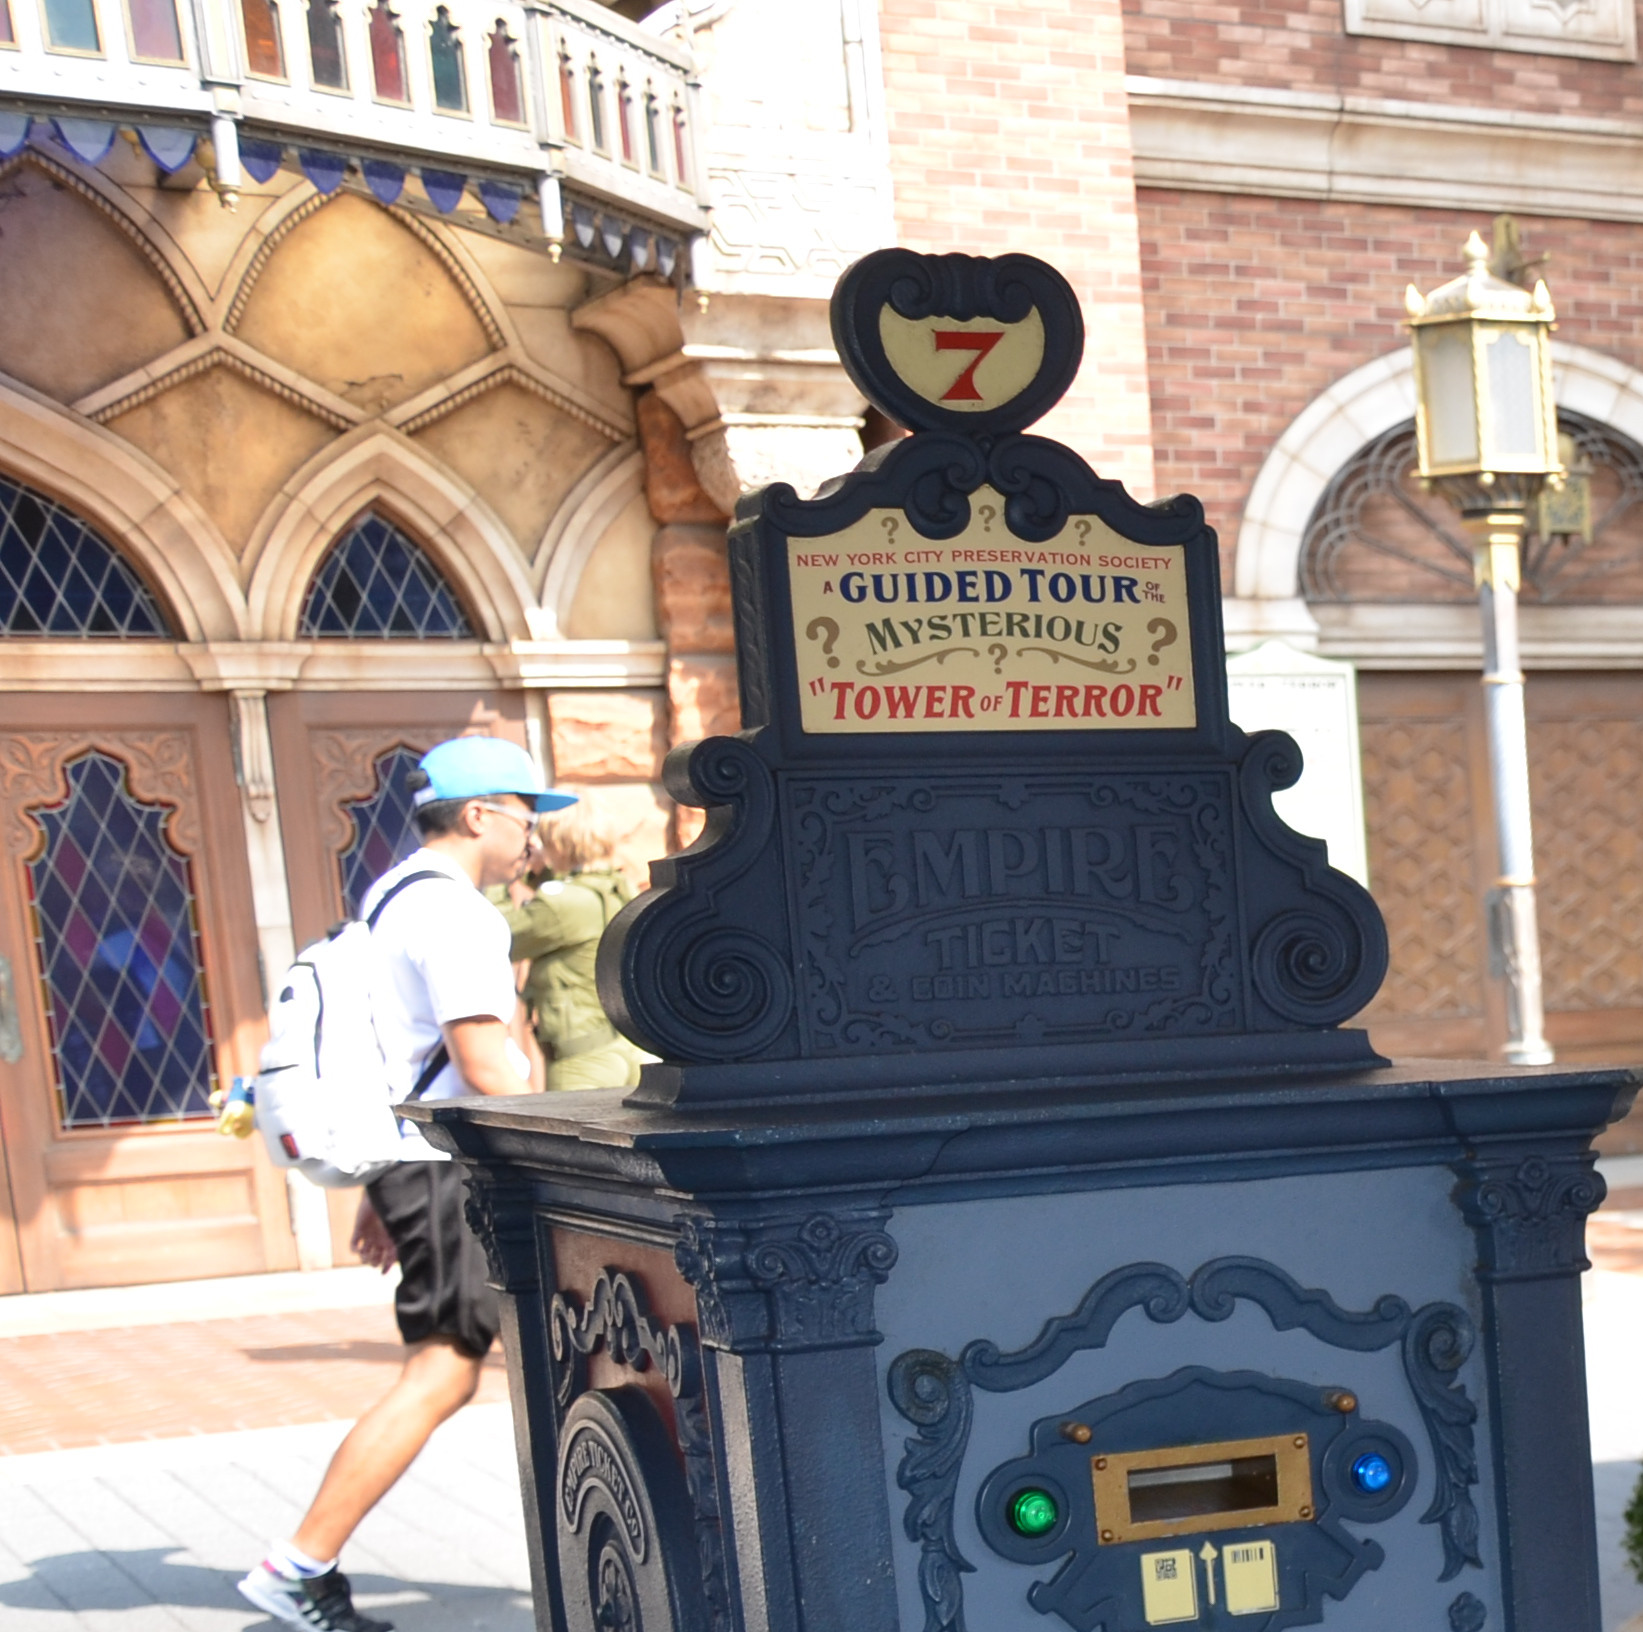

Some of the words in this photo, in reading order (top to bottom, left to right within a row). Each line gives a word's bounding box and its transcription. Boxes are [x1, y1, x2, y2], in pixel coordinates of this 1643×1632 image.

[931, 329, 1005, 401] 7
[797, 553, 840, 568] NEW
[846, 551, 898, 566] YORK
[904, 550, 944, 564] CITY
[952, 549, 1091, 567] PRESERVATION
[1098, 555, 1172, 570] SOCIETY
[823, 580, 834, 595] A
[839, 570, 1012, 603] GUIDED
[1020, 568, 1141, 604] TOUR
[1145, 581, 1161, 592] OF
[1142, 590, 1166, 603] THE
[864, 611, 1124, 656] MYSTERIOUS
[808, 677, 976, 720] "TOWER
[980, 695, 1003, 712] OF
[1005, 675, 1183, 719] TERROR"
[847, 825, 1196, 933] EMPIRE
[926, 916, 1120, 970] TICKET
[869, 974, 897, 1001] &
[912, 973, 991, 1001] COIN
[1003, 967, 1181, 998] MACHINES
[564, 1441, 590, 1513] EMPIRE
[588, 1440, 626, 1501] TICKET
